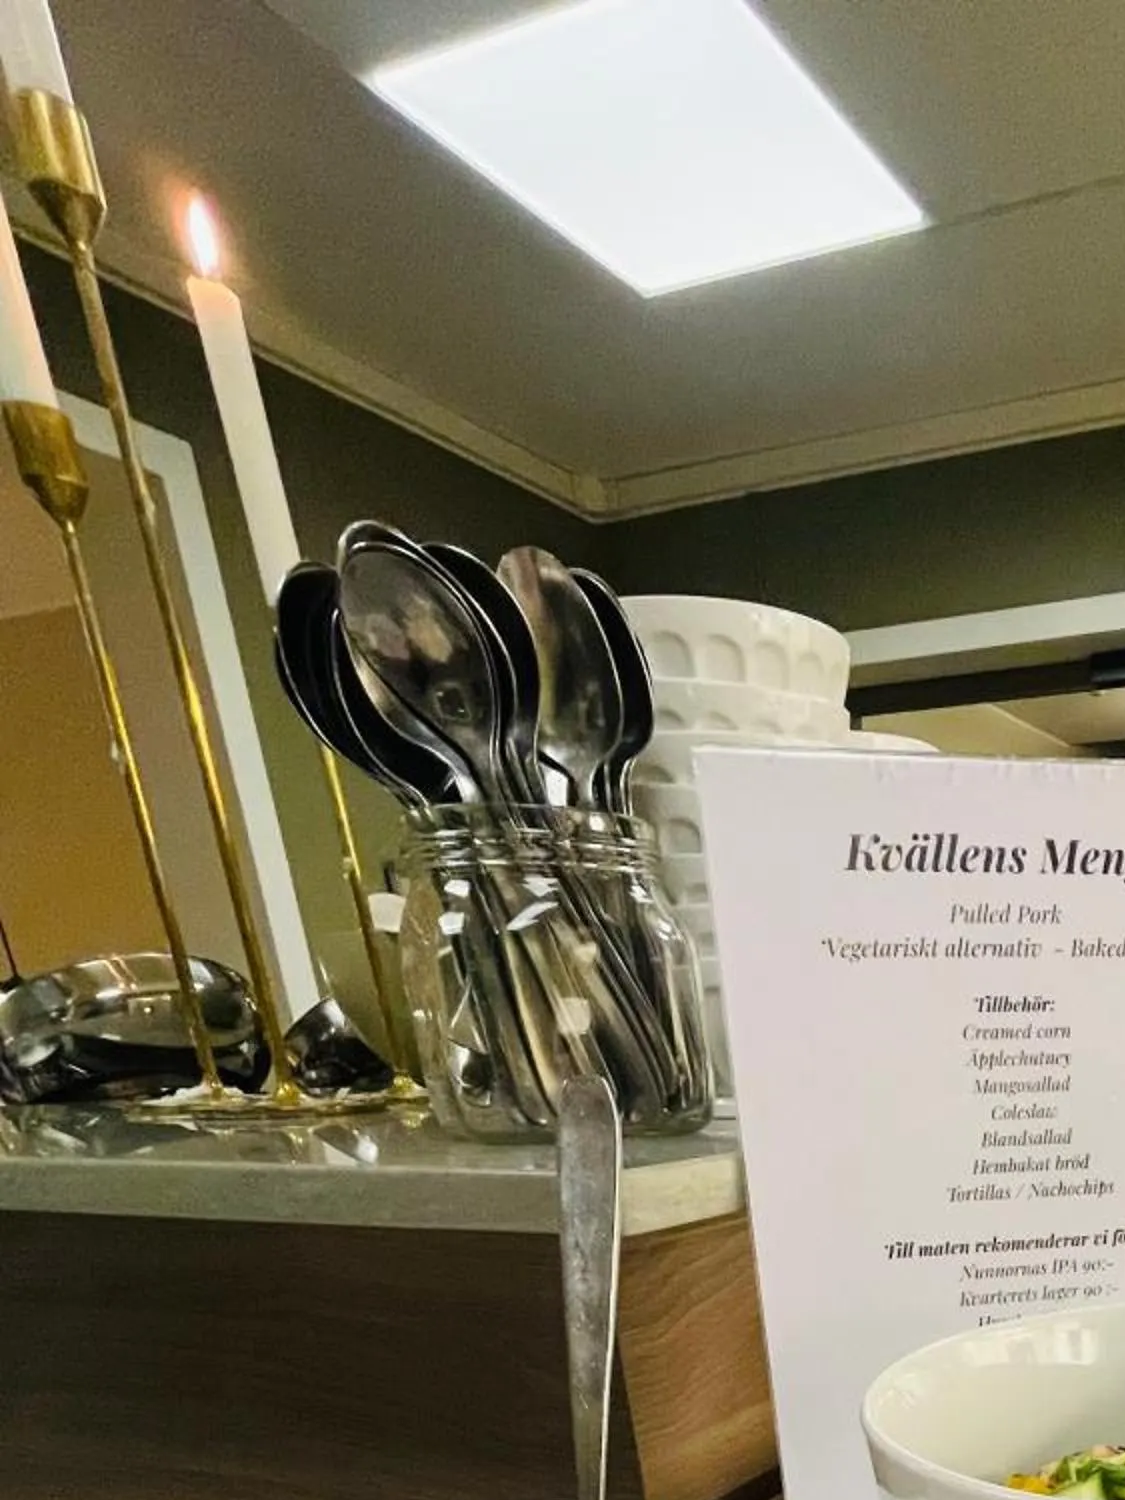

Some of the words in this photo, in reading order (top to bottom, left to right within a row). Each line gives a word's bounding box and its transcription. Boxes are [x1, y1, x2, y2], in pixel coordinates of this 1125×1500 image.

[844, 832, 1028, 875] Kvällens
[949, 902, 1012, 925] Pulled
[1017, 902, 1063, 925] Pork
[821, 936, 939, 963] Vegetariskt
[944, 936, 1042, 959] alternativ
[974, 993, 1056, 1014] Tillbehör:
[961, 1022, 1033, 1041] Creamed
[1035, 1025, 1072, 1041] corn
[966, 1047, 1072, 1072] Äpplechutney
[972, 1074, 1072, 1098] Mangosallad
[990, 1102, 1059, 1122] Coleslaw
[980, 1127, 1074, 1149] Blandsallad
[972, 1155, 1051, 1176] Hembakat
[1054, 1153, 1091, 1172] bröd
[946, 1183, 1012, 1203] Tortillas
[1026, 1177, 1116, 1200] Nachochips
[884, 1240, 914, 1260] Till
[917, 1239, 970, 1258] maten
[1093, 1229, 1110, 1246] vi
[1051, 1257, 1079, 1275] IPA
